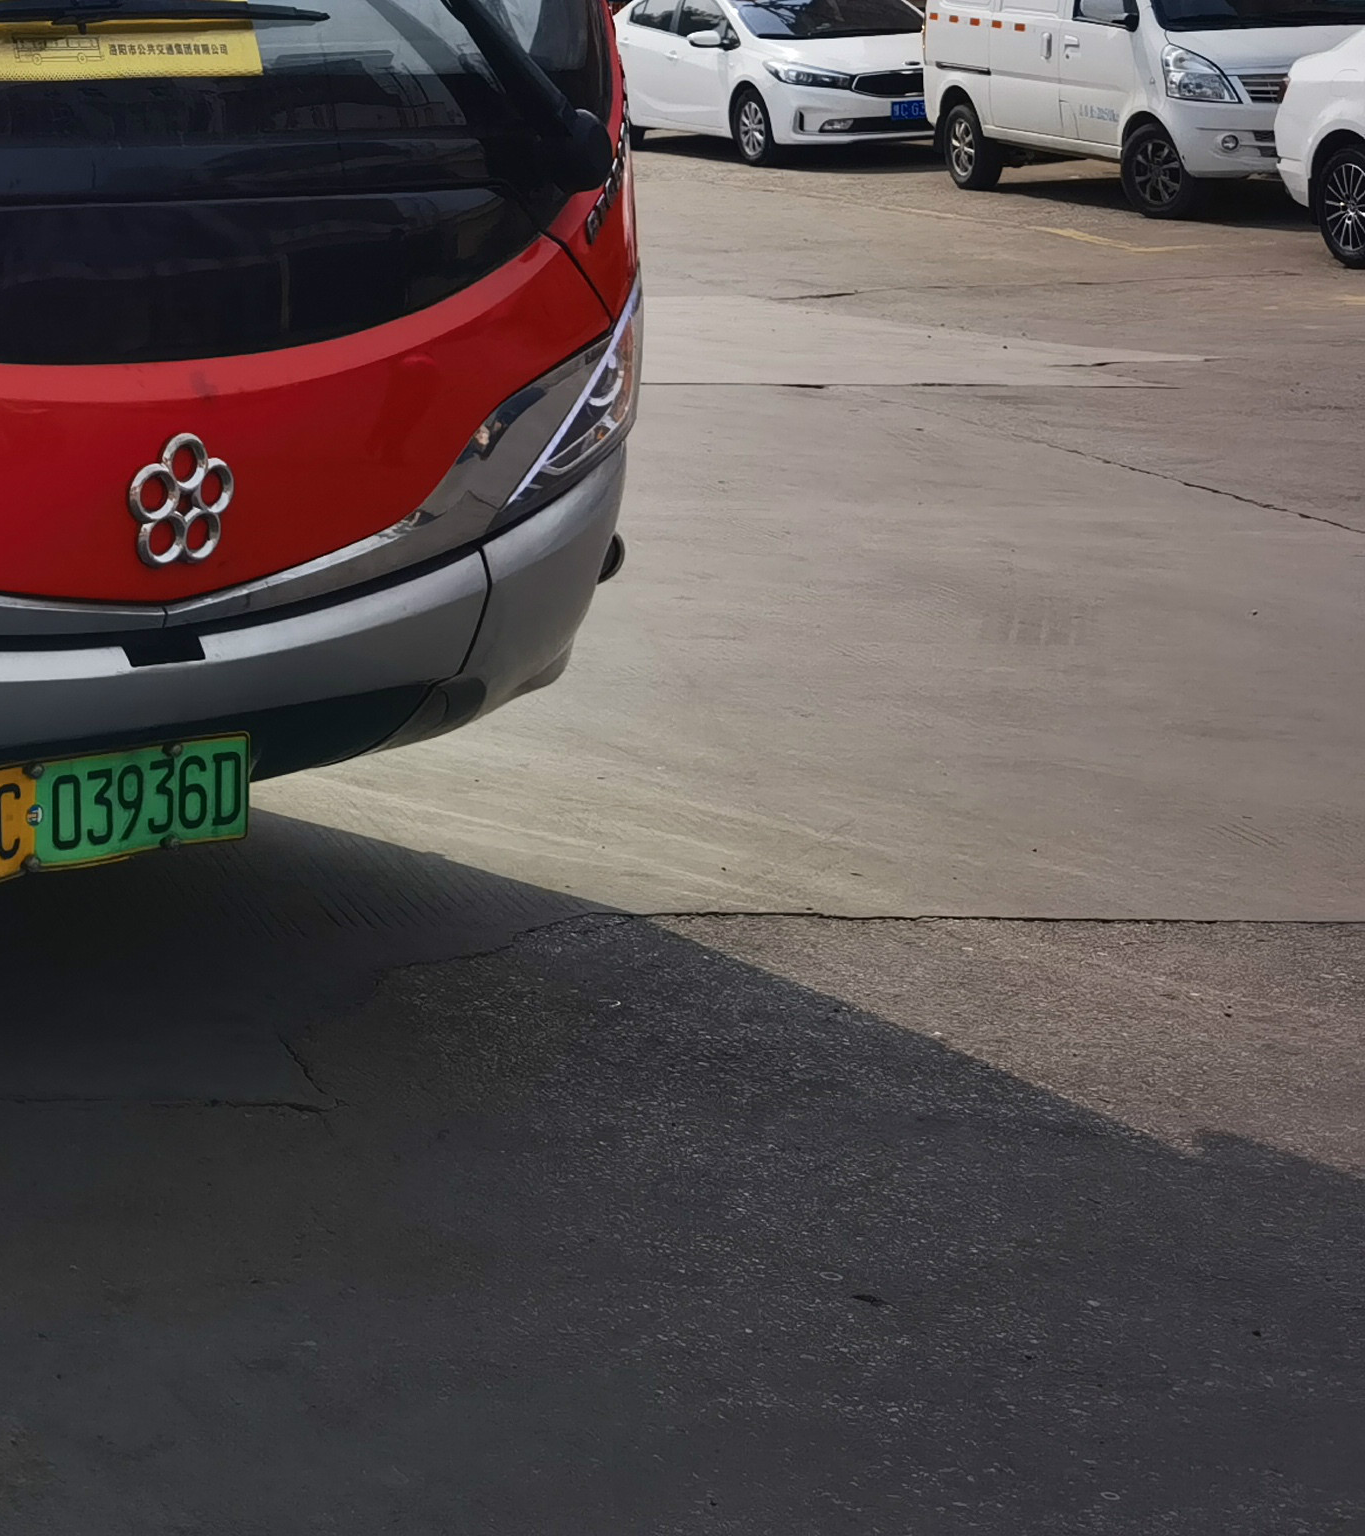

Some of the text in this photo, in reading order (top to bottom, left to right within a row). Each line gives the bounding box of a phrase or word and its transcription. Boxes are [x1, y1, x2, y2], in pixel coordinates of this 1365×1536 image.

[108, 43, 229, 56] 洛阳市公共交通集团有限公司
